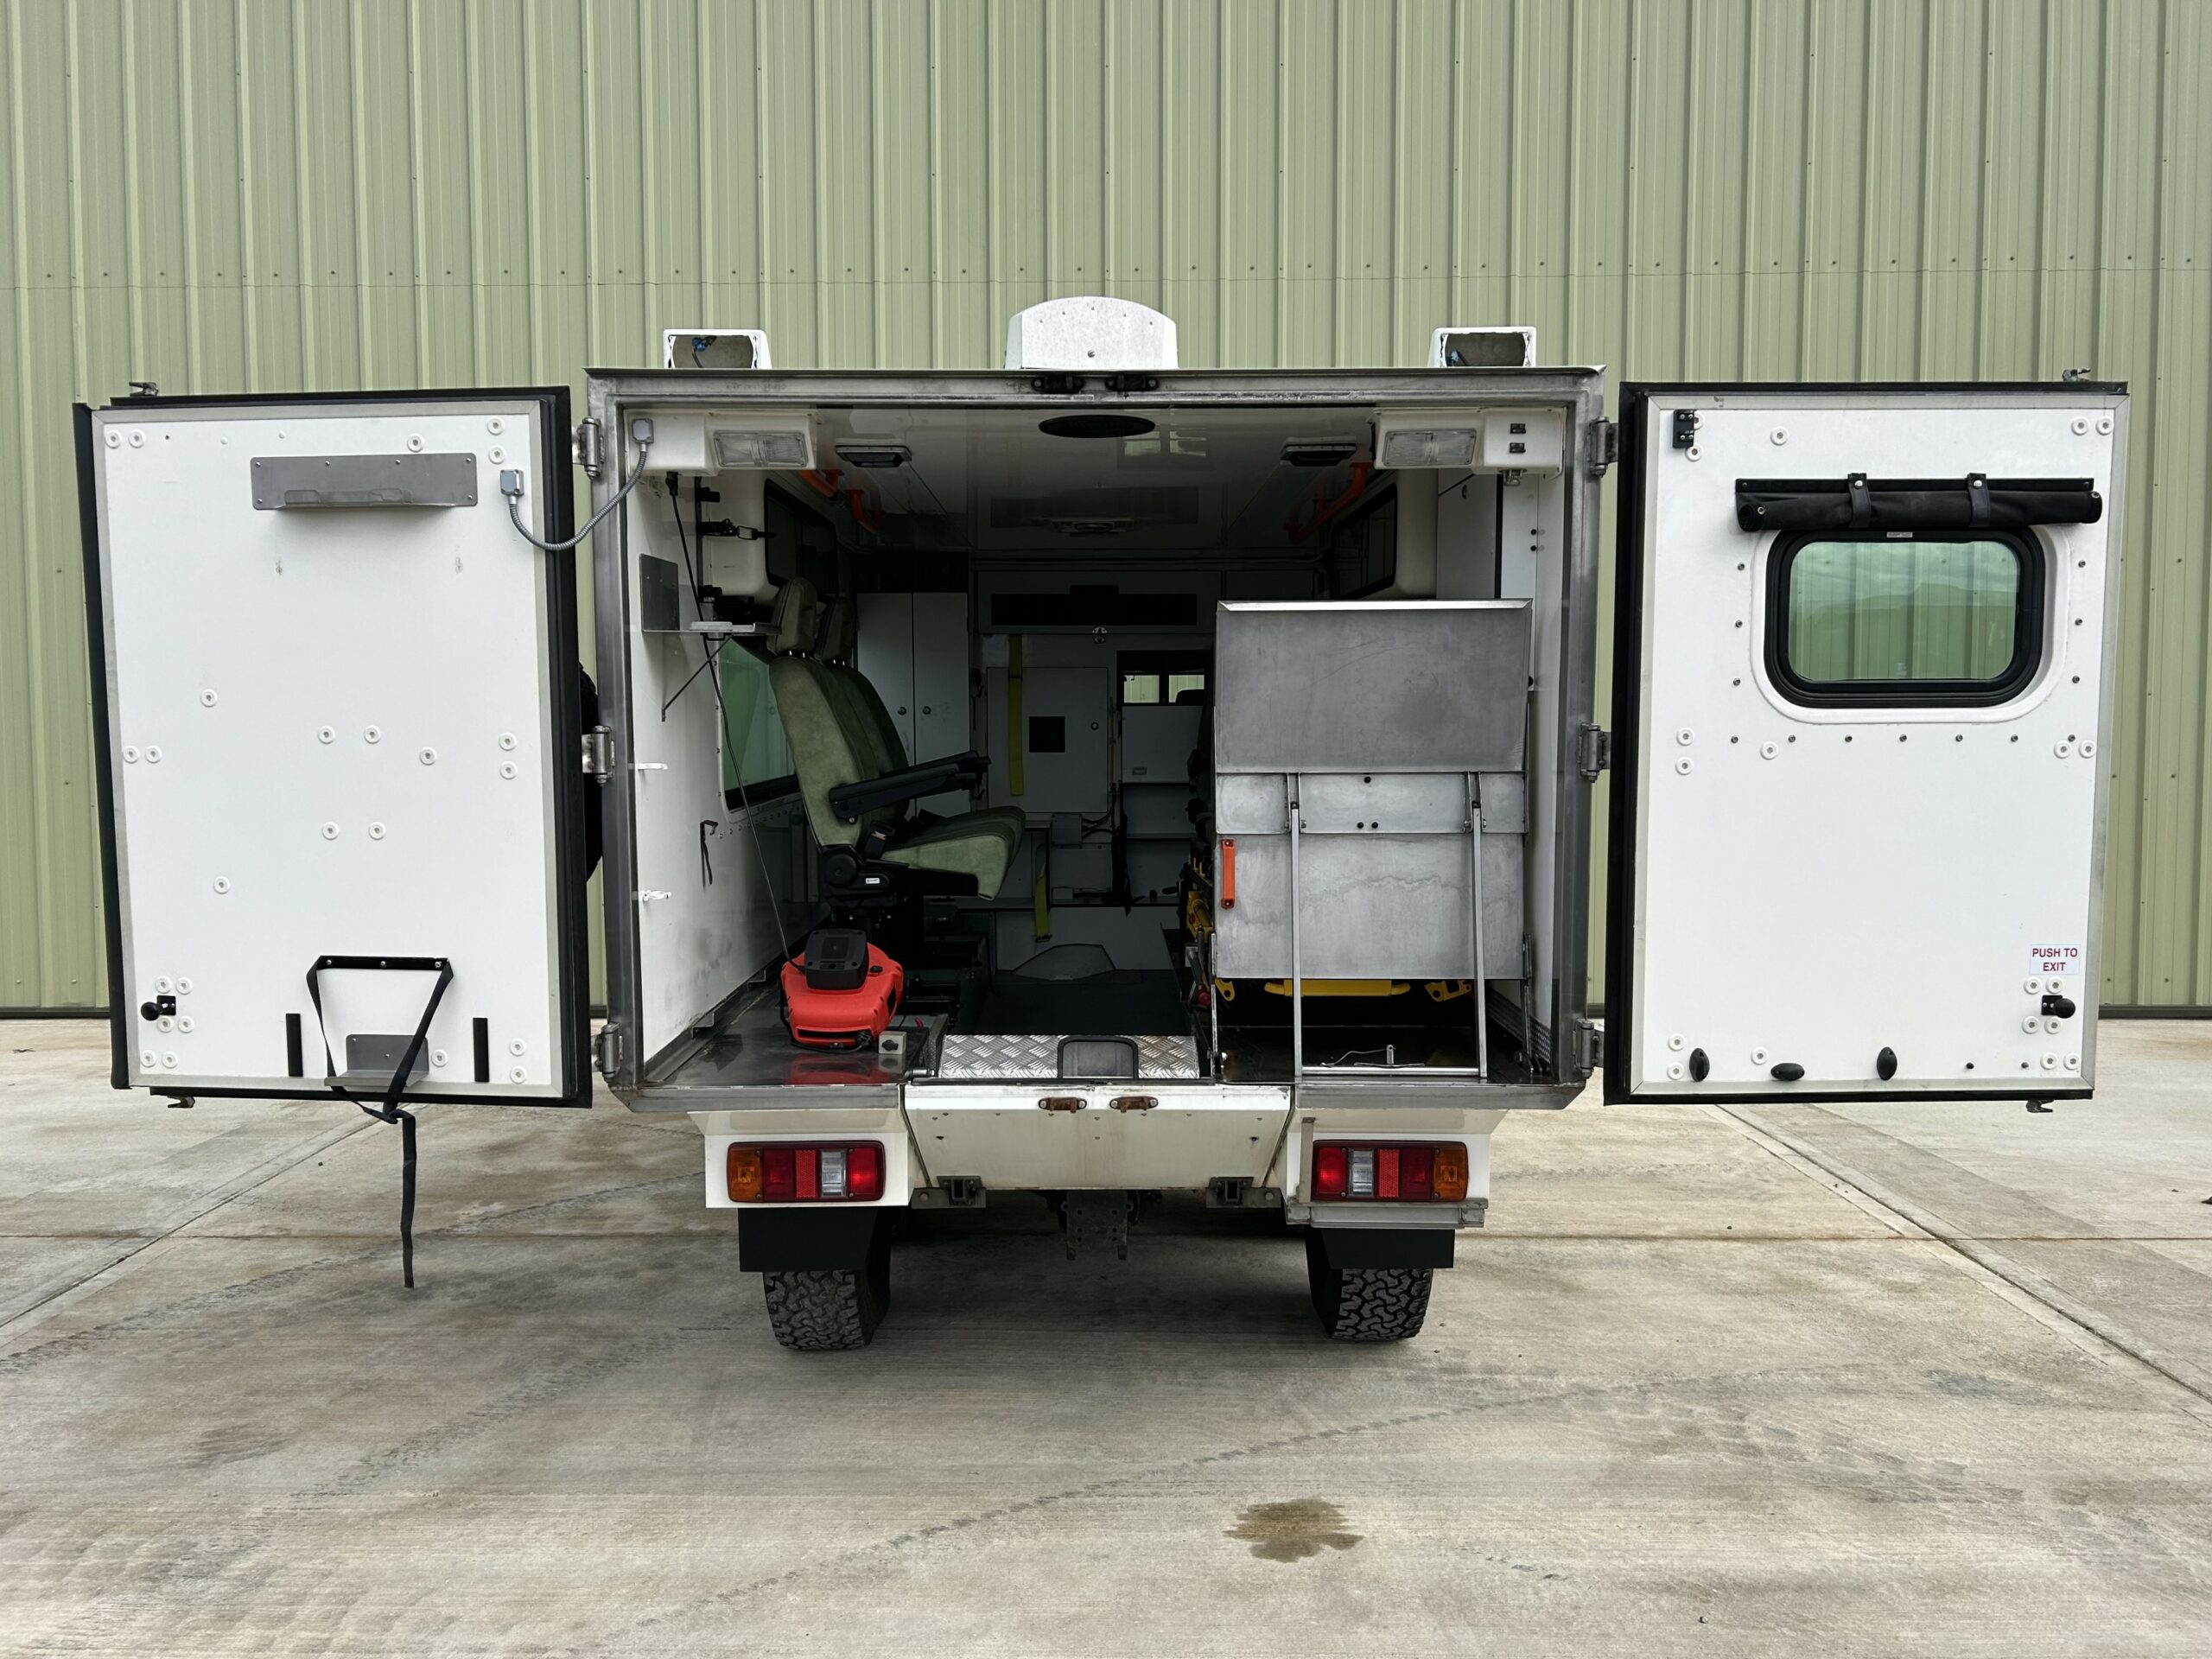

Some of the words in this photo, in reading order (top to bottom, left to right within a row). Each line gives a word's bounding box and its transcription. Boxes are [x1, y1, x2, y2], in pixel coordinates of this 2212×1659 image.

[2032, 948, 2061, 957] PUSH
[2063, 948, 2078, 957] TO
[2043, 962, 2066, 971] EXIT
